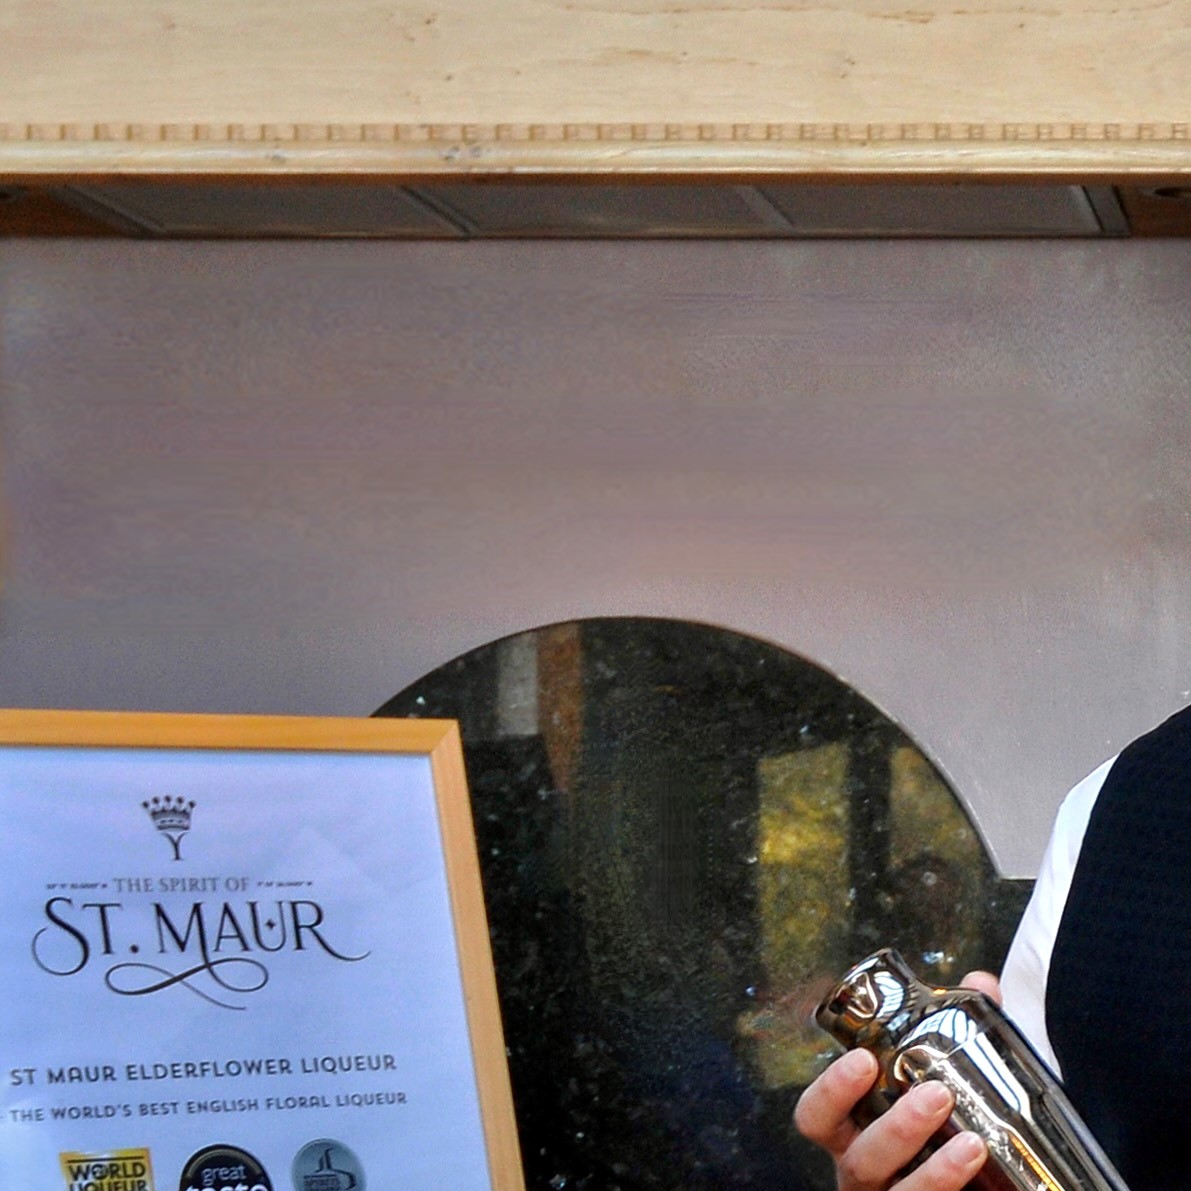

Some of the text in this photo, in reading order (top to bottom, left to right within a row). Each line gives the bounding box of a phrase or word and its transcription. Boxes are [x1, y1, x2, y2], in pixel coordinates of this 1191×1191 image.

[113, 878, 153, 893] THE
[159, 877, 219, 893] SPIRIT
[225, 877, 250, 892] OF
[31, 896, 372, 990] ST. MAUR
[10, 1054, 397, 1086] ST MAUR ELDERFLOWER LIQUEUR
[9, 1092, 408, 1123] THE WORLD'S BEST ENGLISH FLORAL LIQUEUR
[68, 1162, 146, 1181] WORLD
[202, 1163, 248, 1187] great
